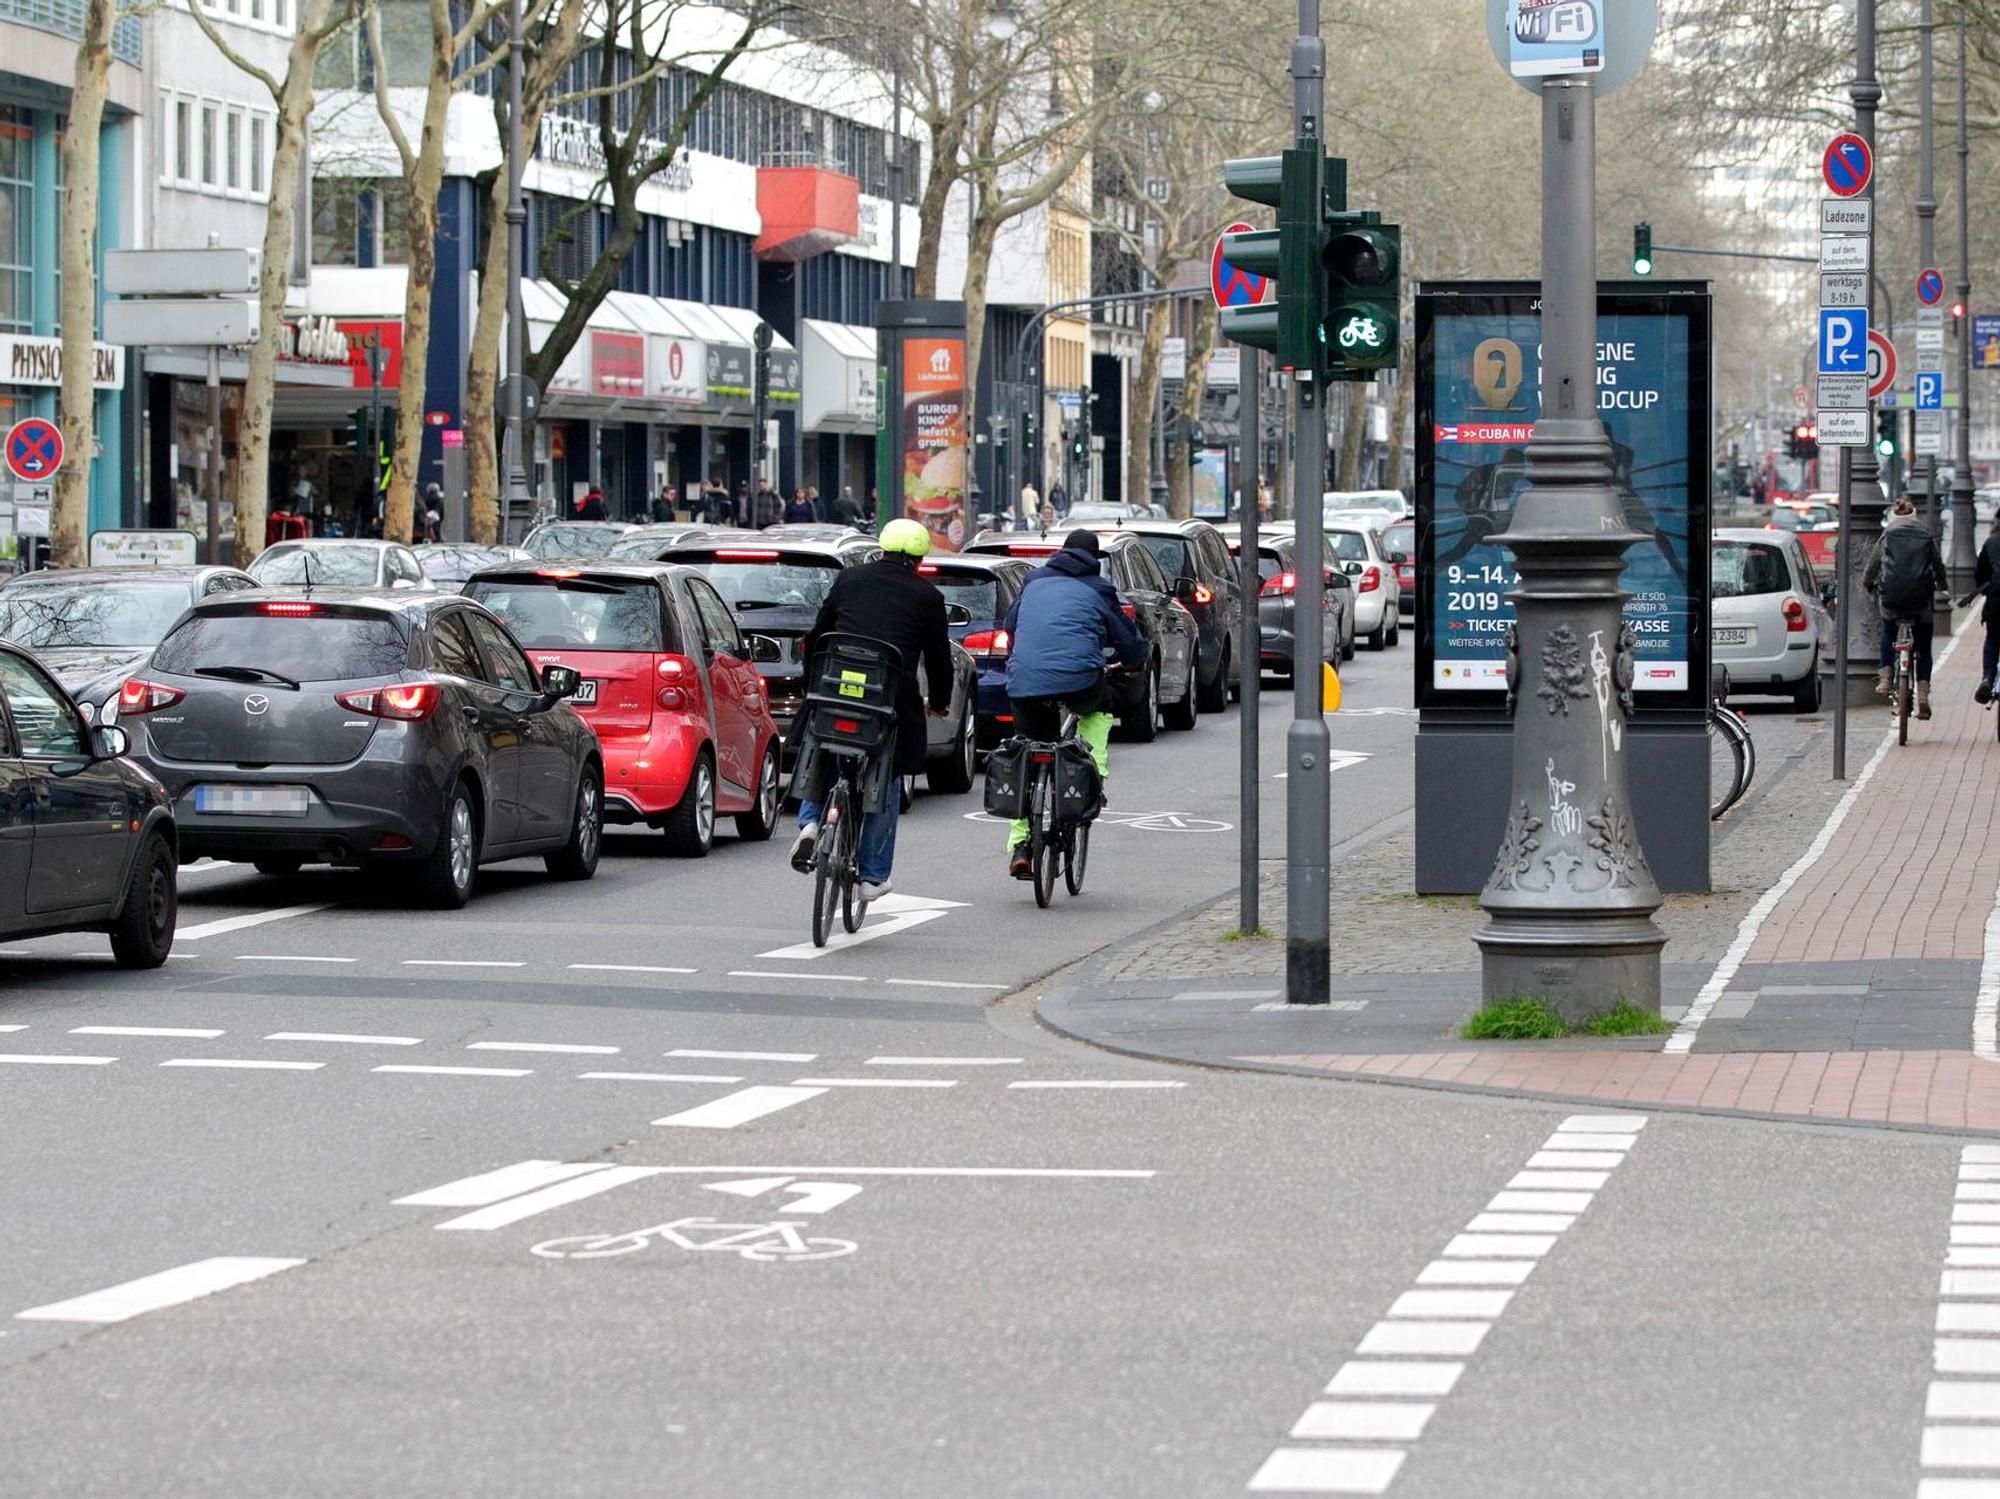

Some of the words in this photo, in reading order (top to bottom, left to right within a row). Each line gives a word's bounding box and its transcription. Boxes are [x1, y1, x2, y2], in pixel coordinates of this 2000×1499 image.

[1825, 209, 1865, 222] Ladezone
[1827, 277, 1862, 289] werktags
[1826, 317, 1852, 365] P
[1919, 377, 1935, 406] P
[918, 404, 958, 414] BURGER
[1829, 418, 1839, 426] auf
[1478, 429, 1510, 439] CUBA
[1513, 429, 1525, 439] IN
[1820, 429, 1865, 437] Seitenstreifen
[1448, 592, 1499, 611] 2019
[1623, 620, 1670, 632] KASSE
